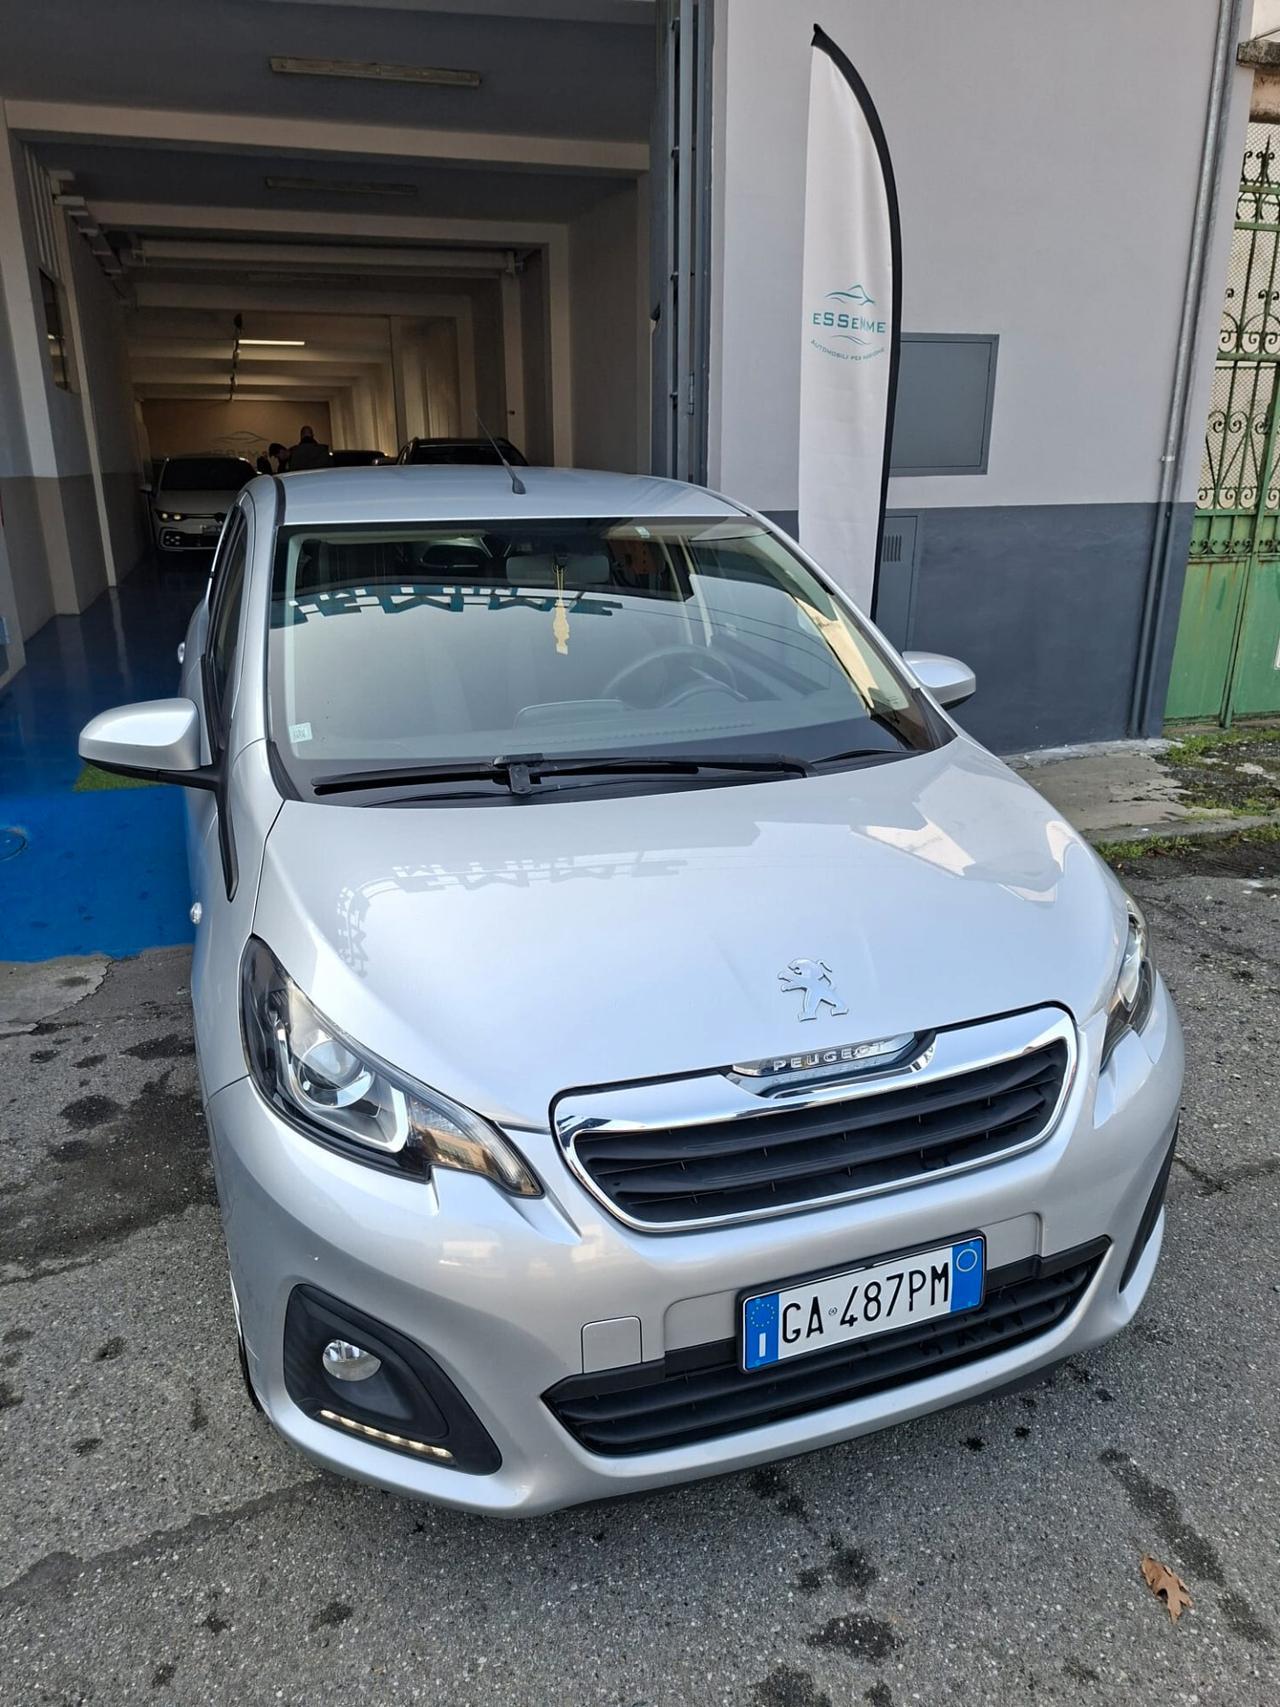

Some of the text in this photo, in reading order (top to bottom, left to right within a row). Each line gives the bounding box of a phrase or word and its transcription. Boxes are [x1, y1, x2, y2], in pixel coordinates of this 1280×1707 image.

[773, 1040, 886, 1072] PEUGEOT
[781, 1295, 824, 1344] GA
[839, 1261, 950, 1327] 487PM
